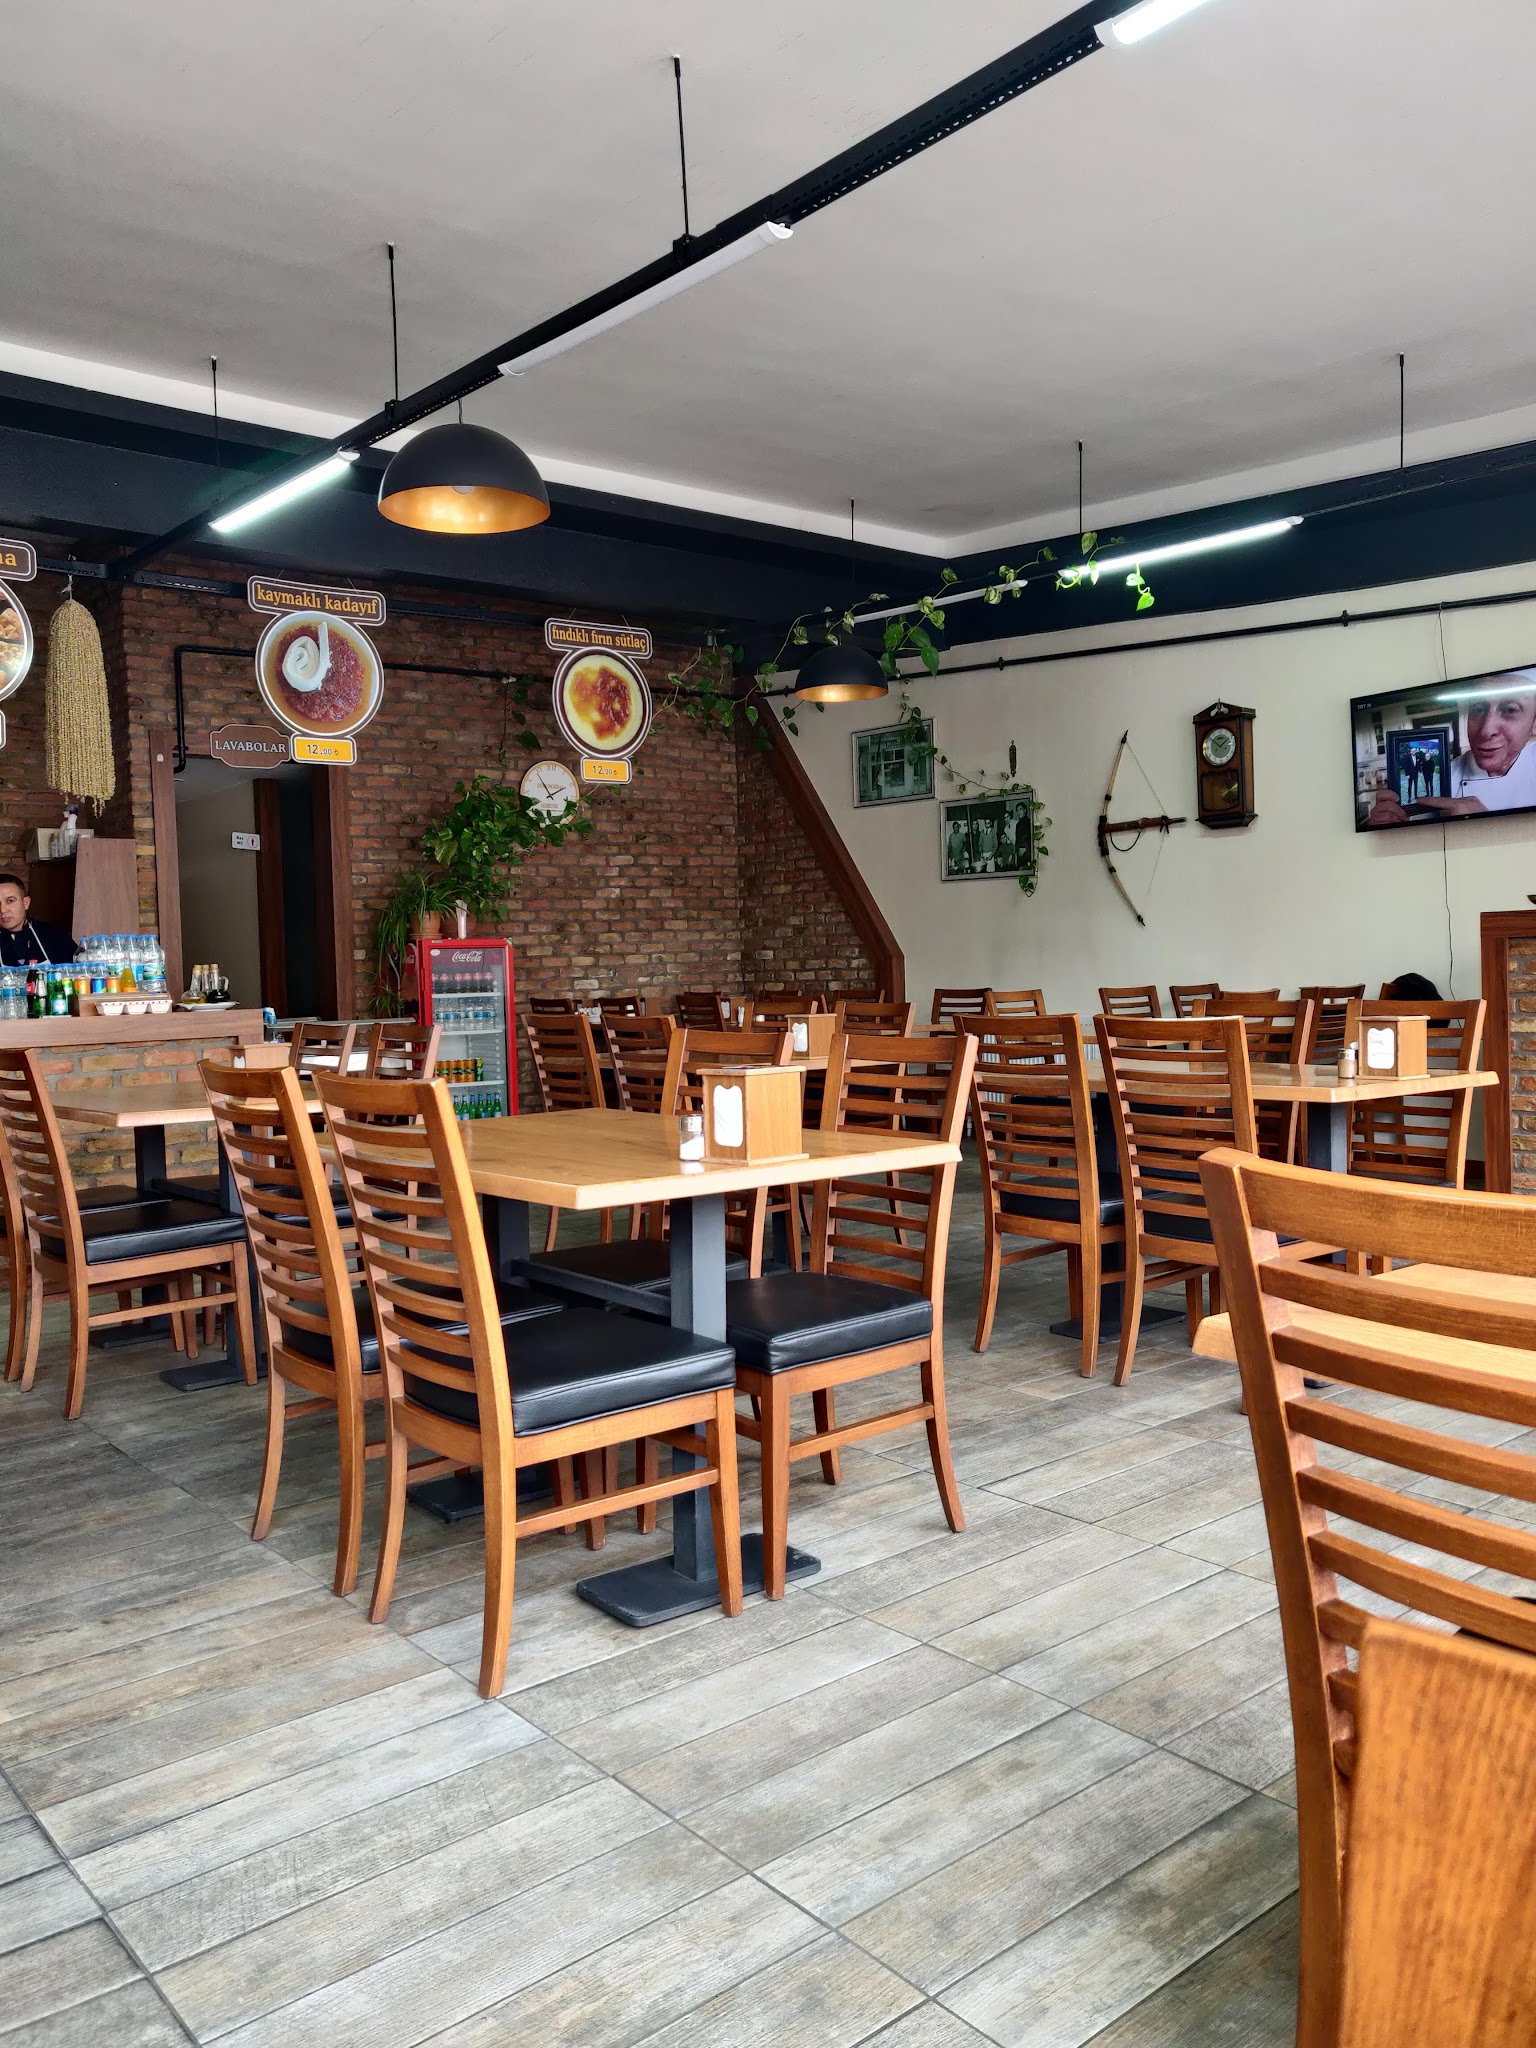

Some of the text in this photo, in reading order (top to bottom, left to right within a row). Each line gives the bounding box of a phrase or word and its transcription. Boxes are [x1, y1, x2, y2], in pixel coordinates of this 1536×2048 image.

[256, 584, 379, 617] kaymaklı kadayıf
[552, 625, 647, 652] fındıklı fırın sütlaç
[215, 740, 287, 753] LAVABOLAR
[452, 950, 483, 963] Coca-Cola
